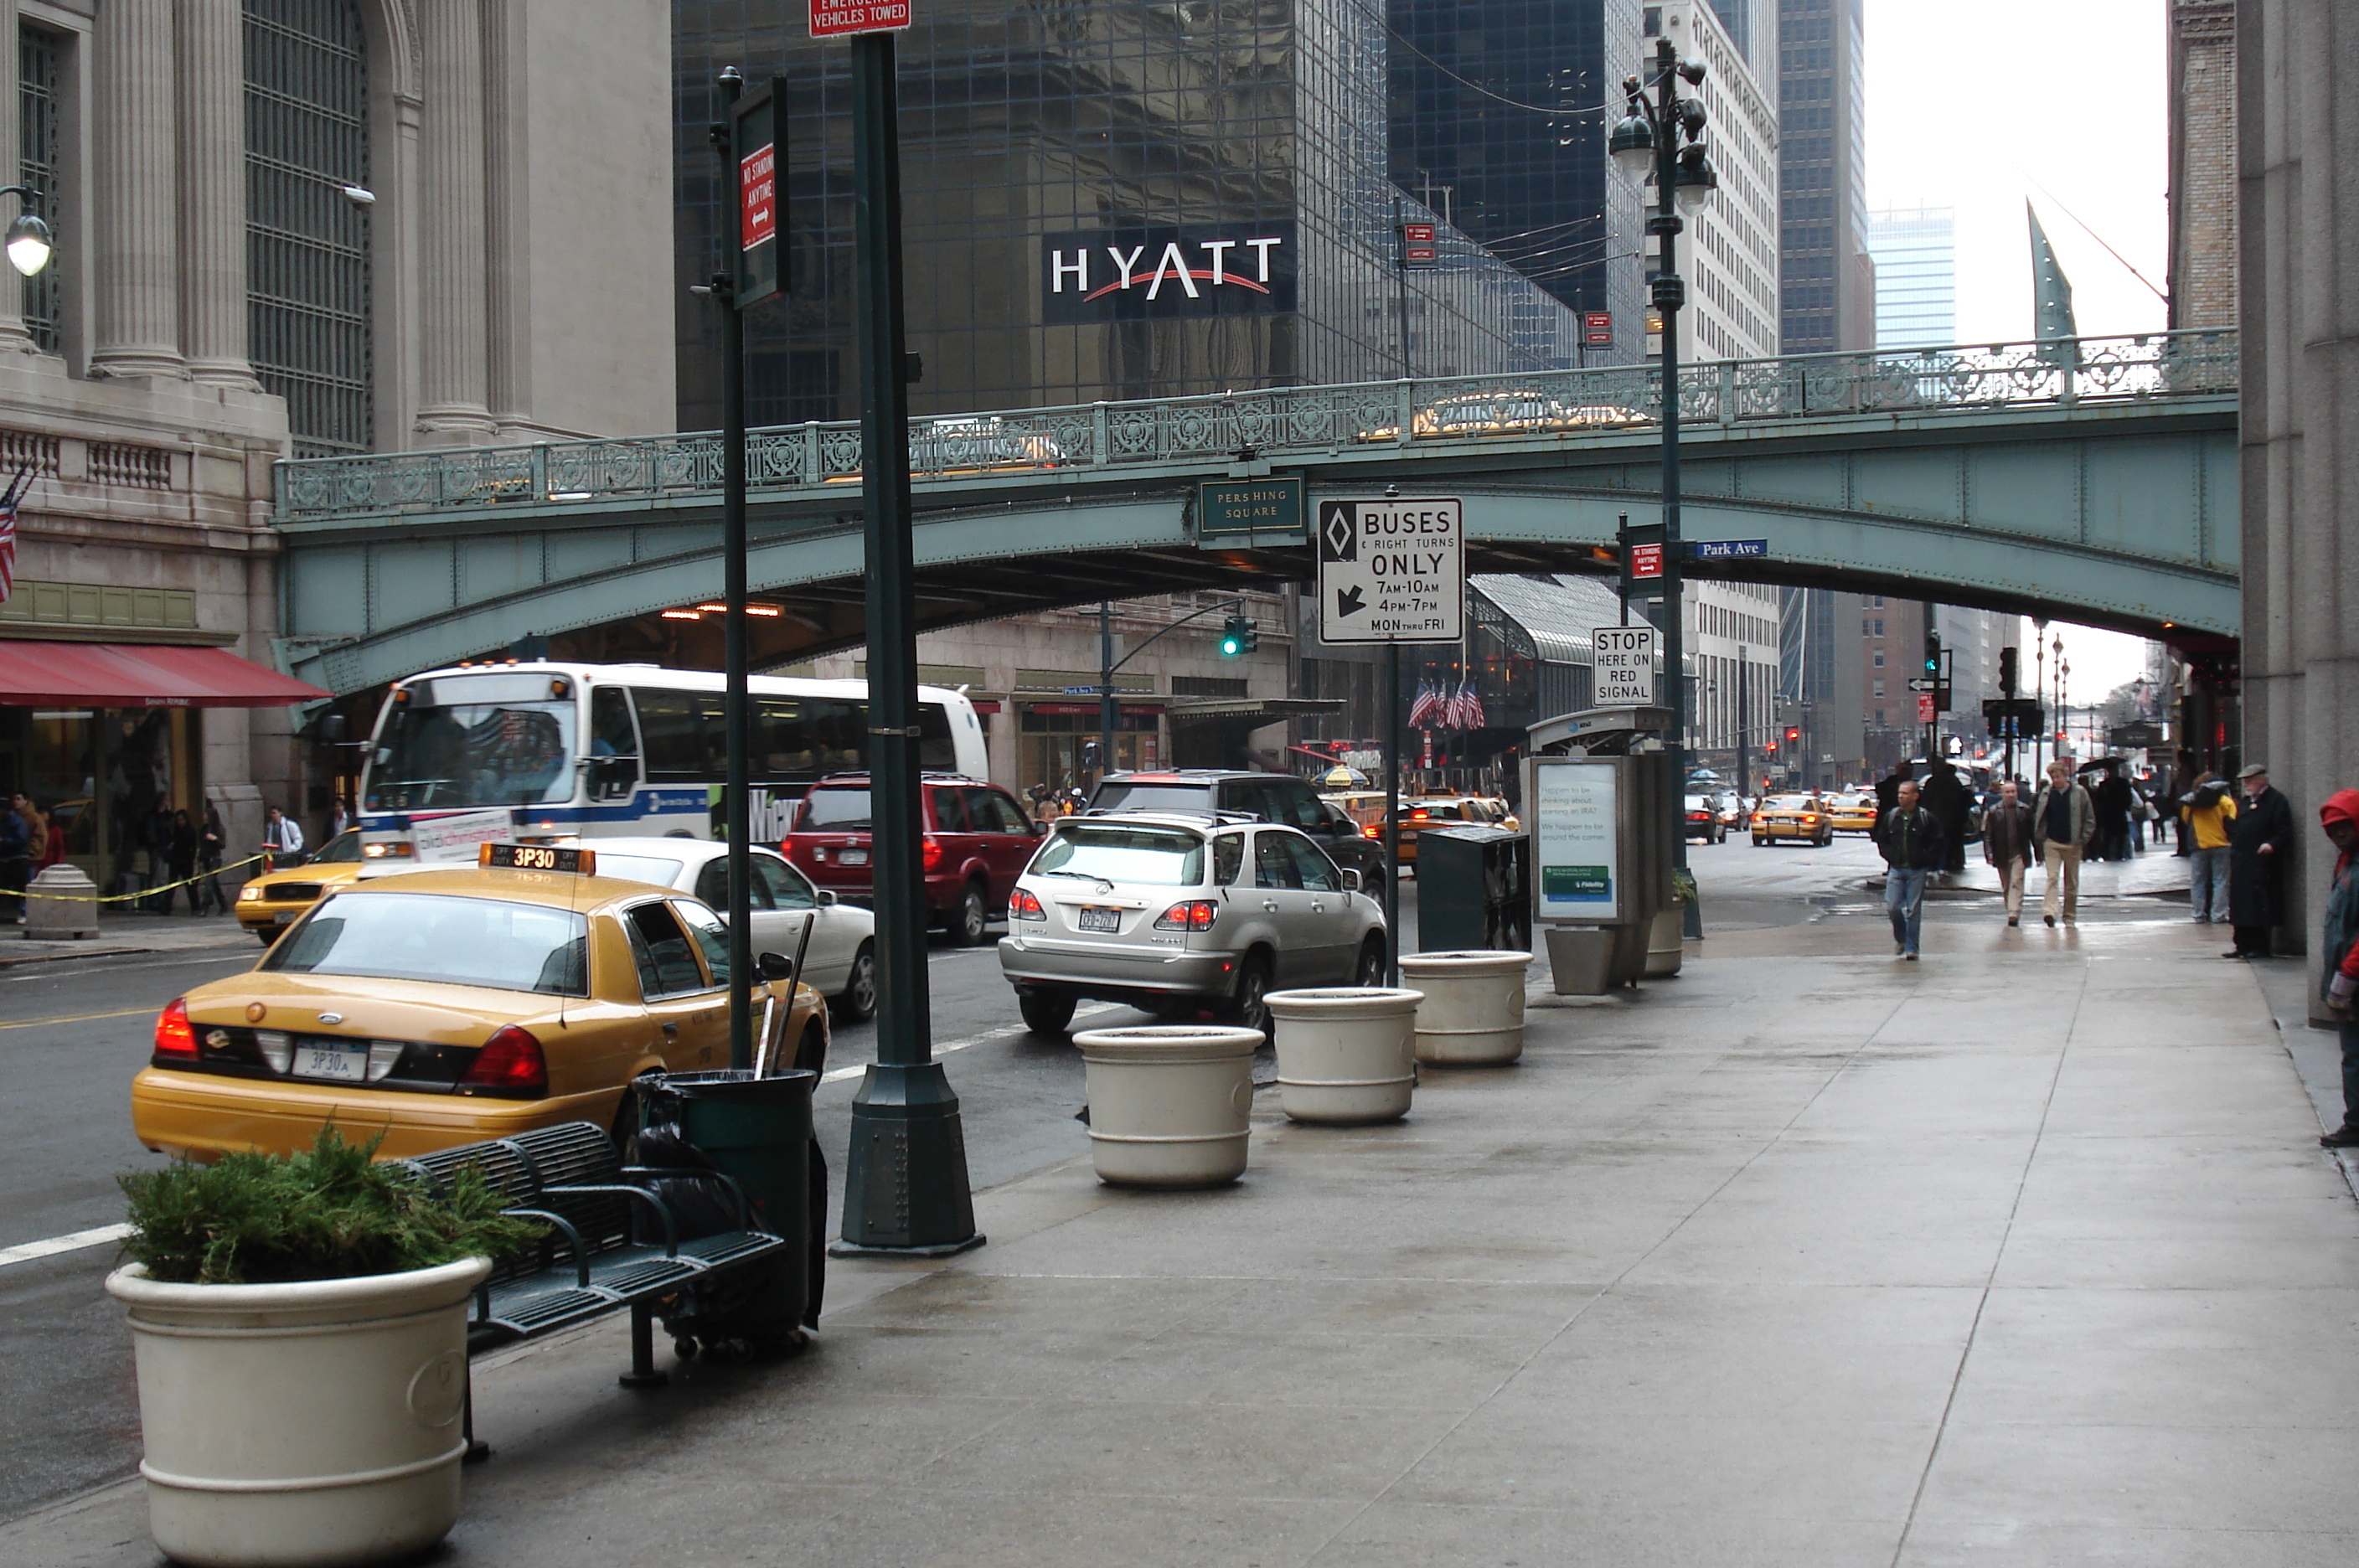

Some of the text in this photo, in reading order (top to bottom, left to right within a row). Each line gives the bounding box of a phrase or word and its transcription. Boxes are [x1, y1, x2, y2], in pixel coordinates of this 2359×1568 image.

[813, 3, 906, 28] VEHICLES TOWED
[747, 179, 772, 208] ANYTIME
[1052, 237, 1282, 301] HYATT
[1217, 491, 1286, 503] PERSHING
[1226, 506, 1278, 518] SQUARE
[1365, 512, 1450, 535] BUSES
[1375, 539, 1408, 549] RIGHT
[1416, 538, 1454, 548] TURNS
[1703, 543, 1759, 555] Park Ave
[1372, 553, 1444, 575] ONLY
[1376, 580, 1440, 595] 7AM-10AM
[1379, 598, 1438, 612] 4PM-7PM
[1371, 620, 1401, 631] MON
[1424, 618, 1445, 630] FRI
[1598, 632, 1649, 651] STOP
[1598, 654, 1649, 667] HERE ON
[1610, 670, 1637, 683] RED
[1599, 686, 1649, 699] SIGNAL
[1541, 787, 1570, 795] Happen
[1556, 823, 1582, 832] happen
[514, 848, 555, 869] 3P30
